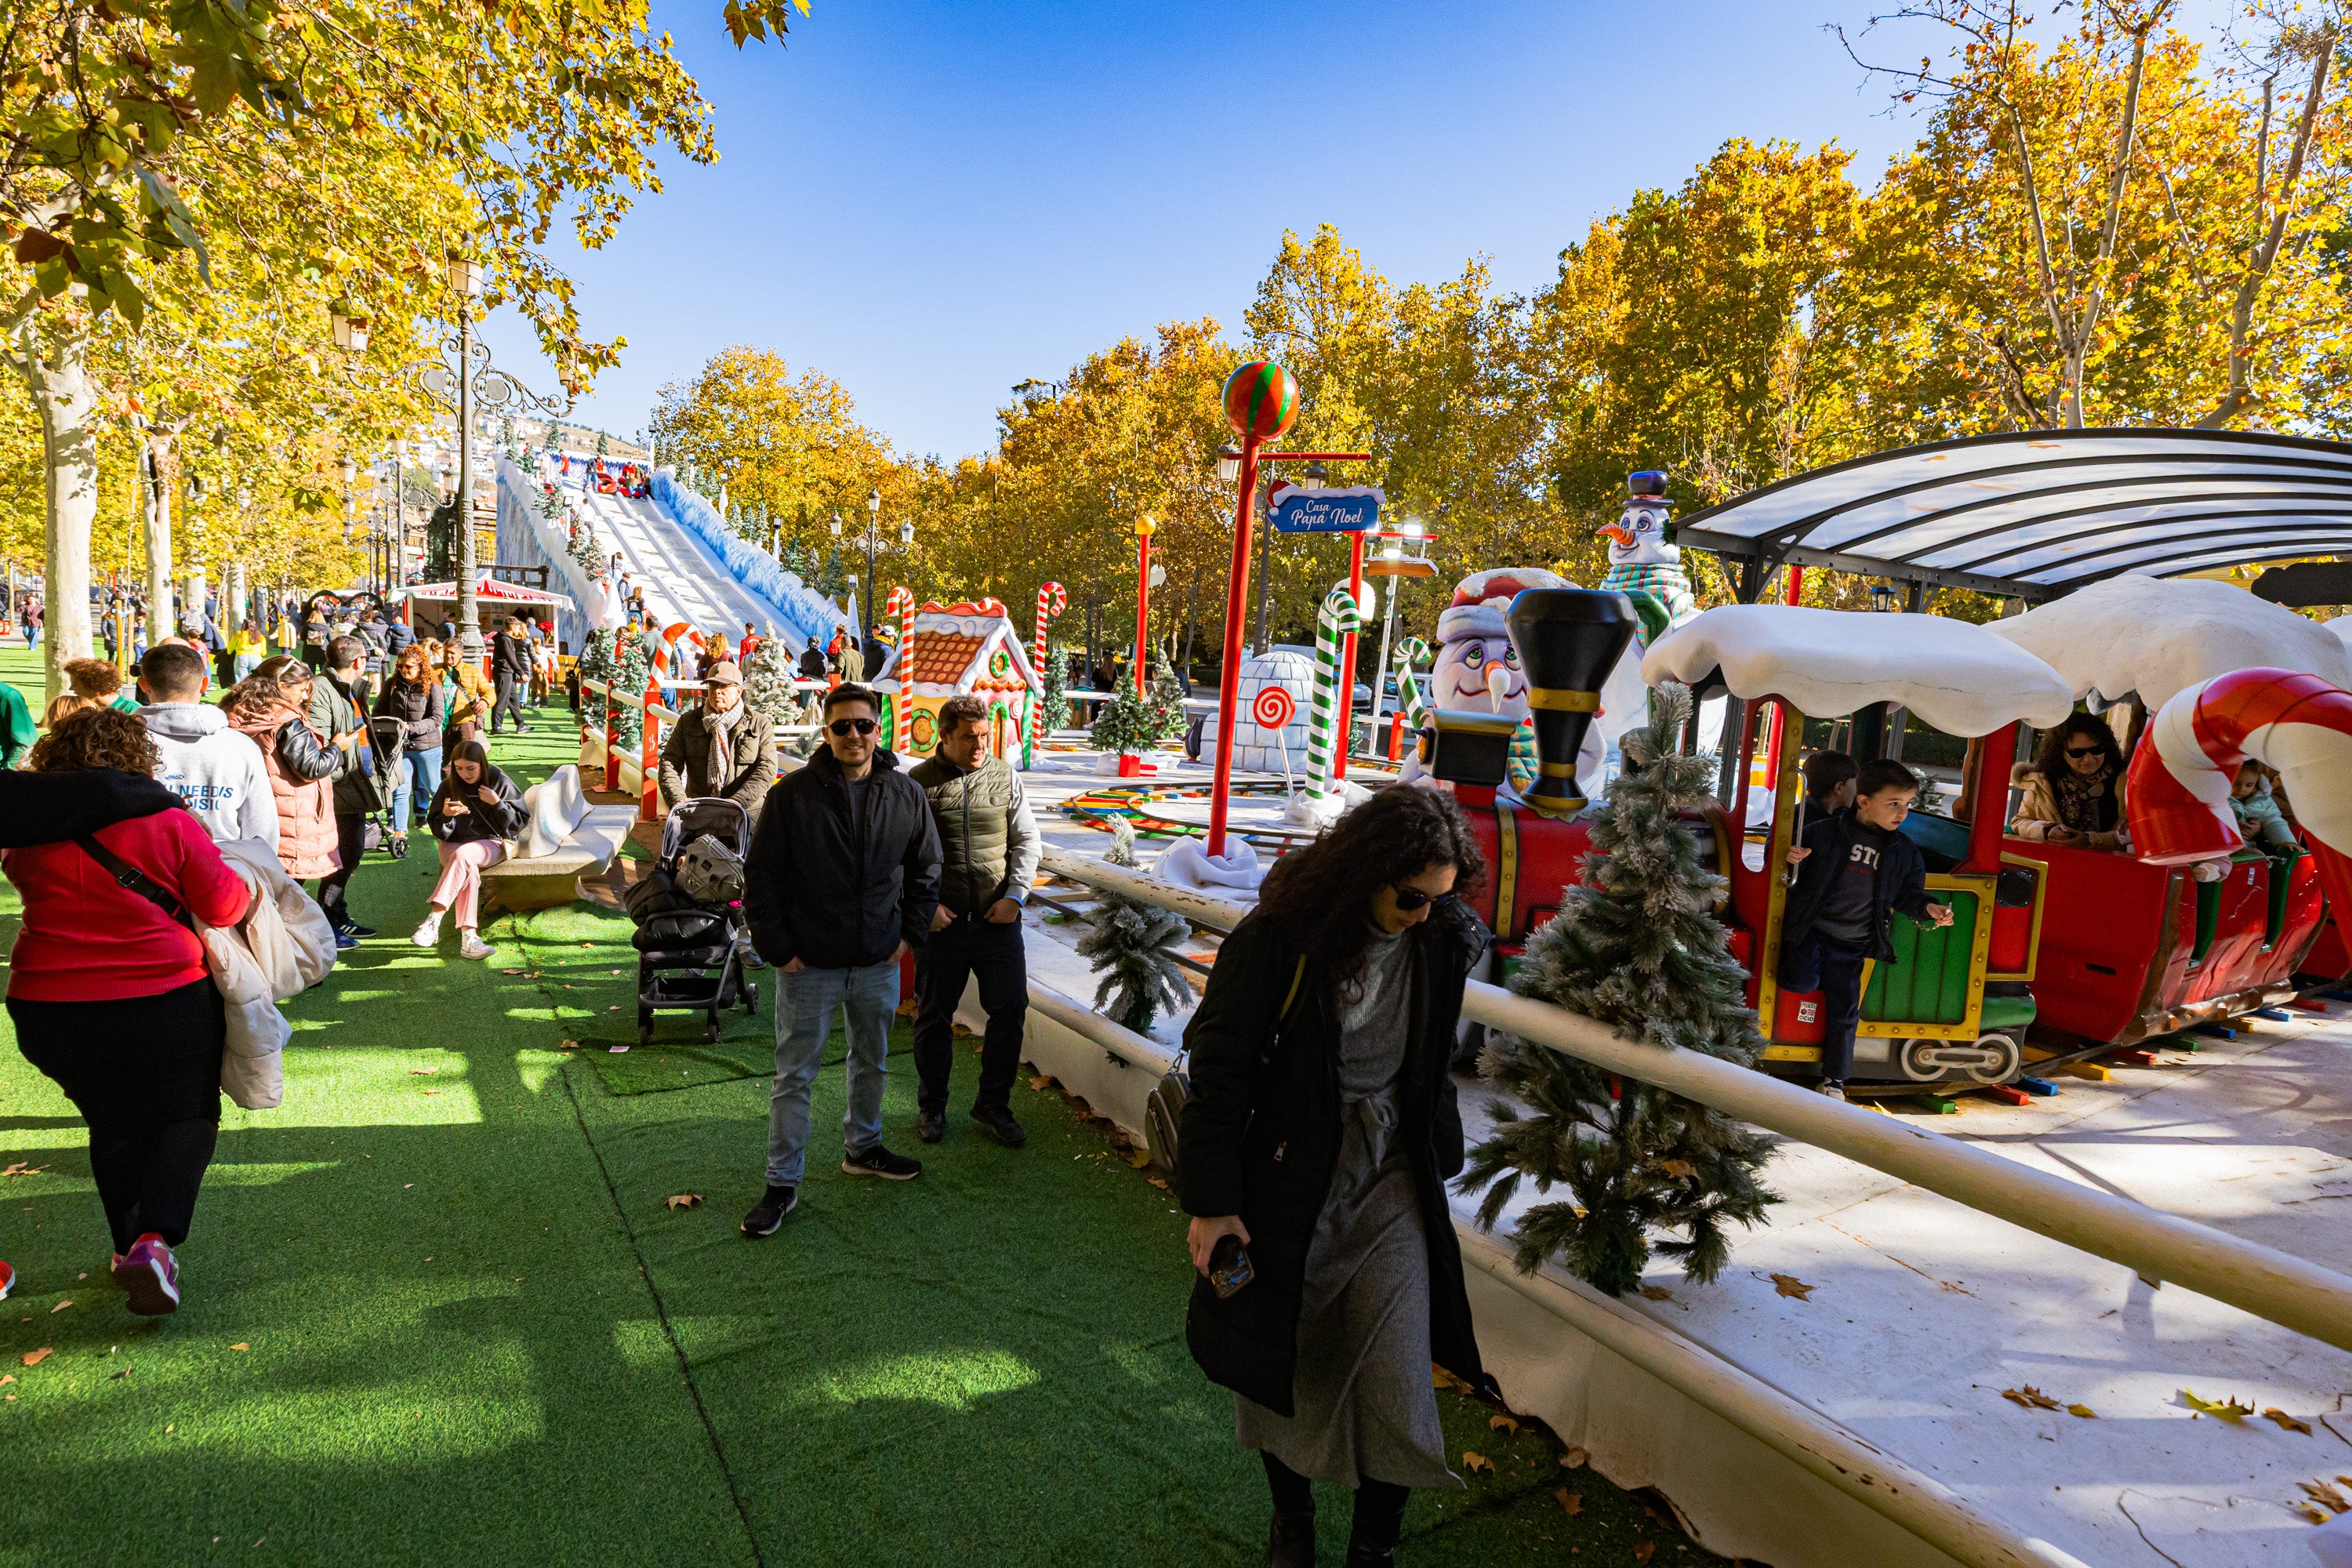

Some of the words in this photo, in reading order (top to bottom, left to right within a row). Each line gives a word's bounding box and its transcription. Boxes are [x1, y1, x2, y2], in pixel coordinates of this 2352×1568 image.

[1306, 499, 1331, 513] Casa
[1290, 509, 1327, 531] Papá
[1330, 507, 1363, 525] Noel
